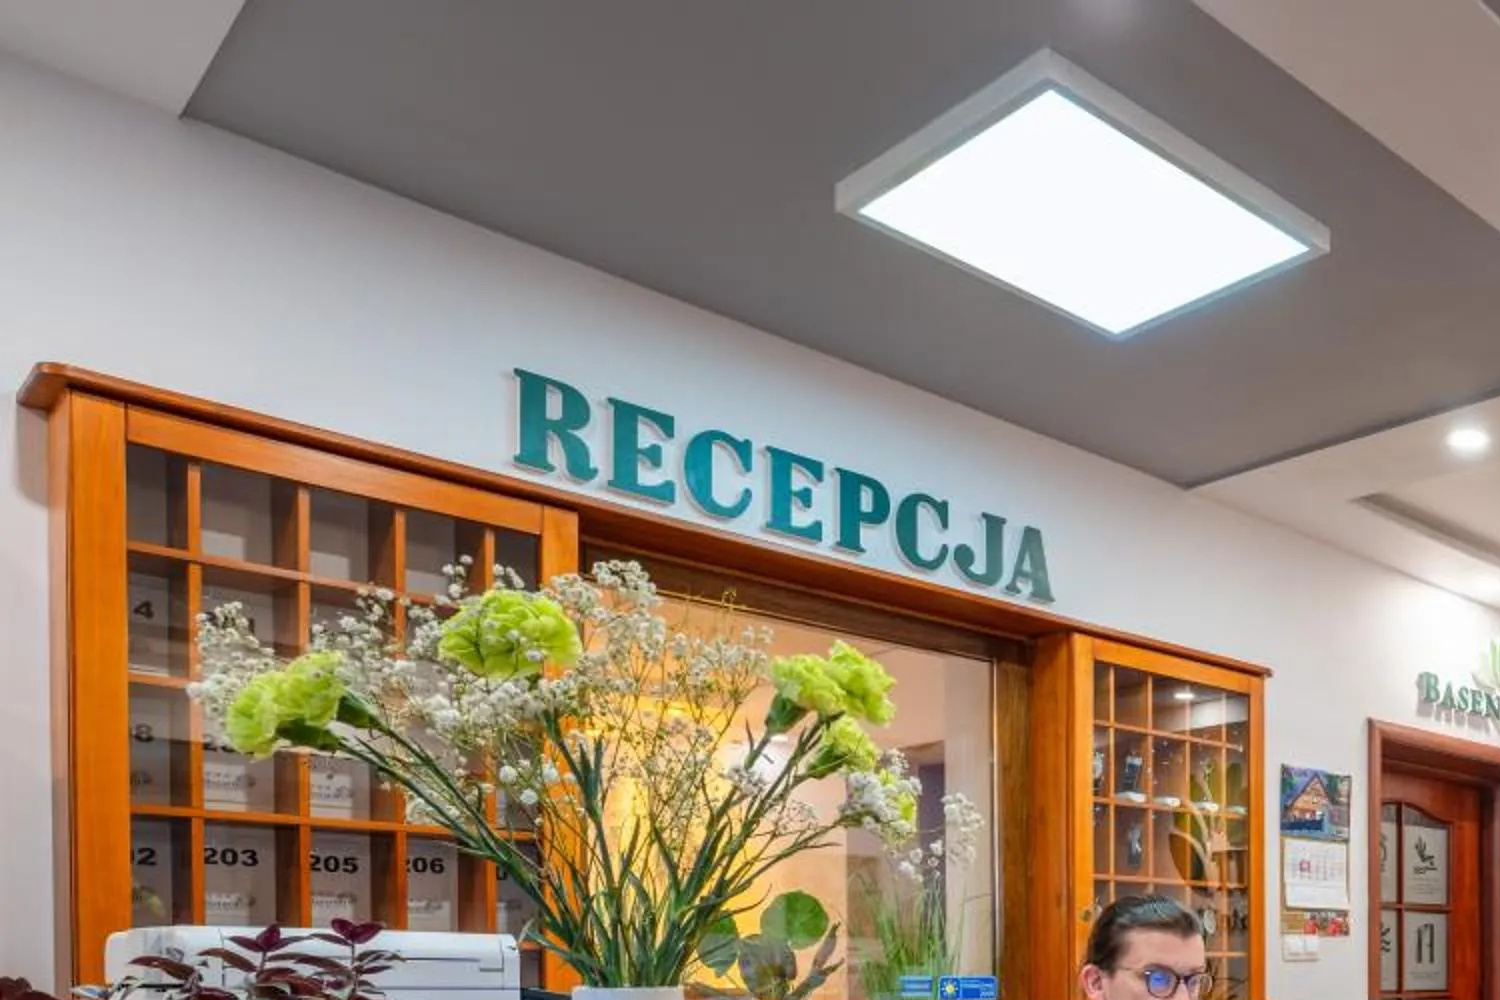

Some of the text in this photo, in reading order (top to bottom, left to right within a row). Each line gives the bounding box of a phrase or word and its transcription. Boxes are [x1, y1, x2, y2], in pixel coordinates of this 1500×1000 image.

[514, 367, 1055, 602] RECEPCJA
[1418, 671, 1500, 721] BASEN
[203, 848, 259, 867] 203
[309, 854, 359, 874] 205
